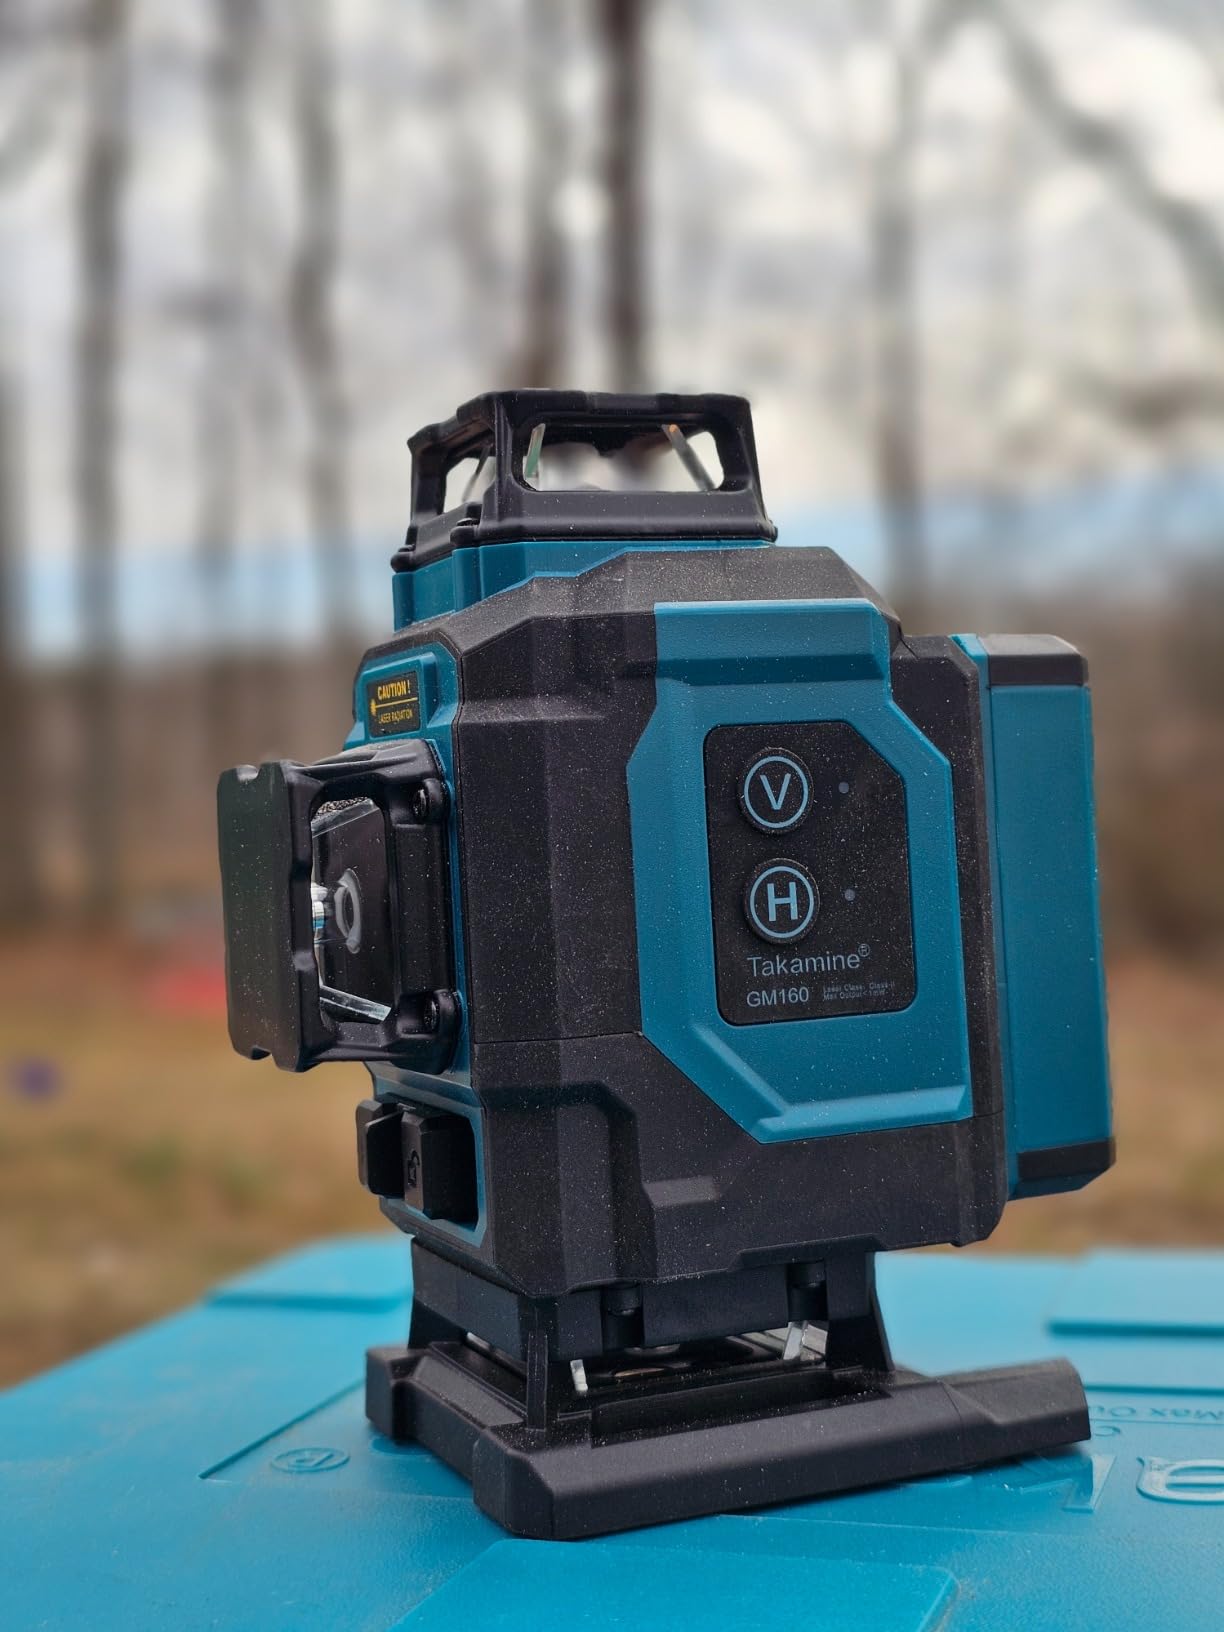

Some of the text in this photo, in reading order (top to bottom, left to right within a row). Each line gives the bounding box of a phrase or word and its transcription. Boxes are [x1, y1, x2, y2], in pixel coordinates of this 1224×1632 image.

[760, 773, 791, 810] V
[767, 881, 799, 921] H
[746, 986, 809, 1007] GM160
